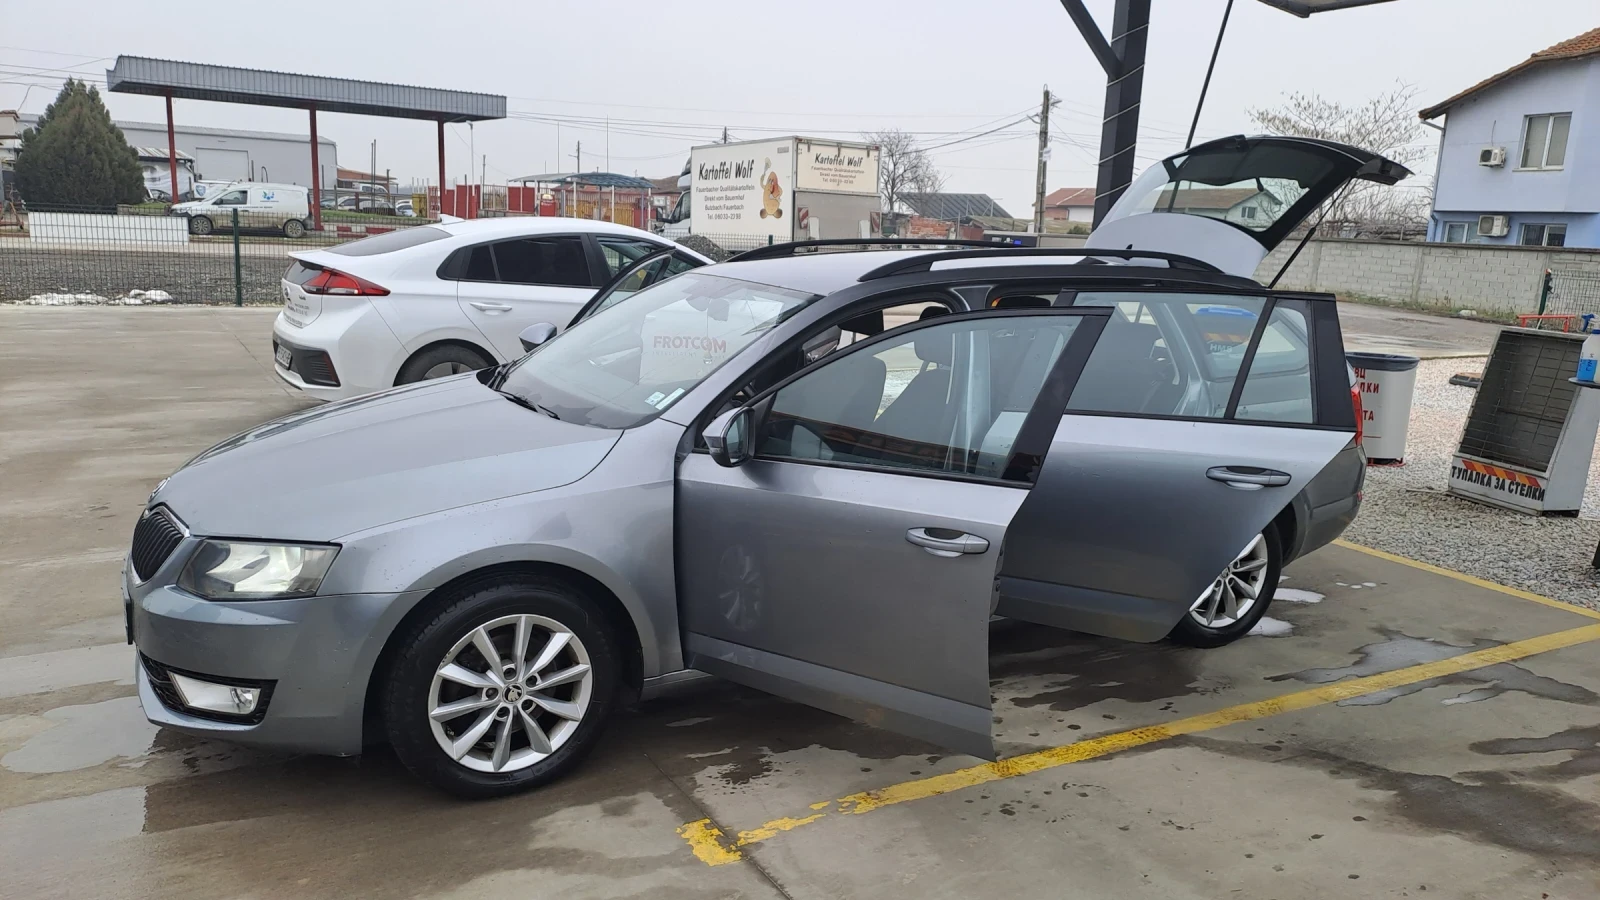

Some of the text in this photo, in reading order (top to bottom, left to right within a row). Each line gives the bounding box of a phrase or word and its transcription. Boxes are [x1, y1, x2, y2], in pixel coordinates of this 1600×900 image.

[698, 159, 755, 180] Kartoffel Wolf
[814, 153, 864, 167] Kartoffel Wolf
[653, 335, 727, 354] FROTCOM
[1363, 410, 1374, 421] ТА
[1451, 466, 1546, 502] ТУПАЛКА ЗА СТЕЛКИ
